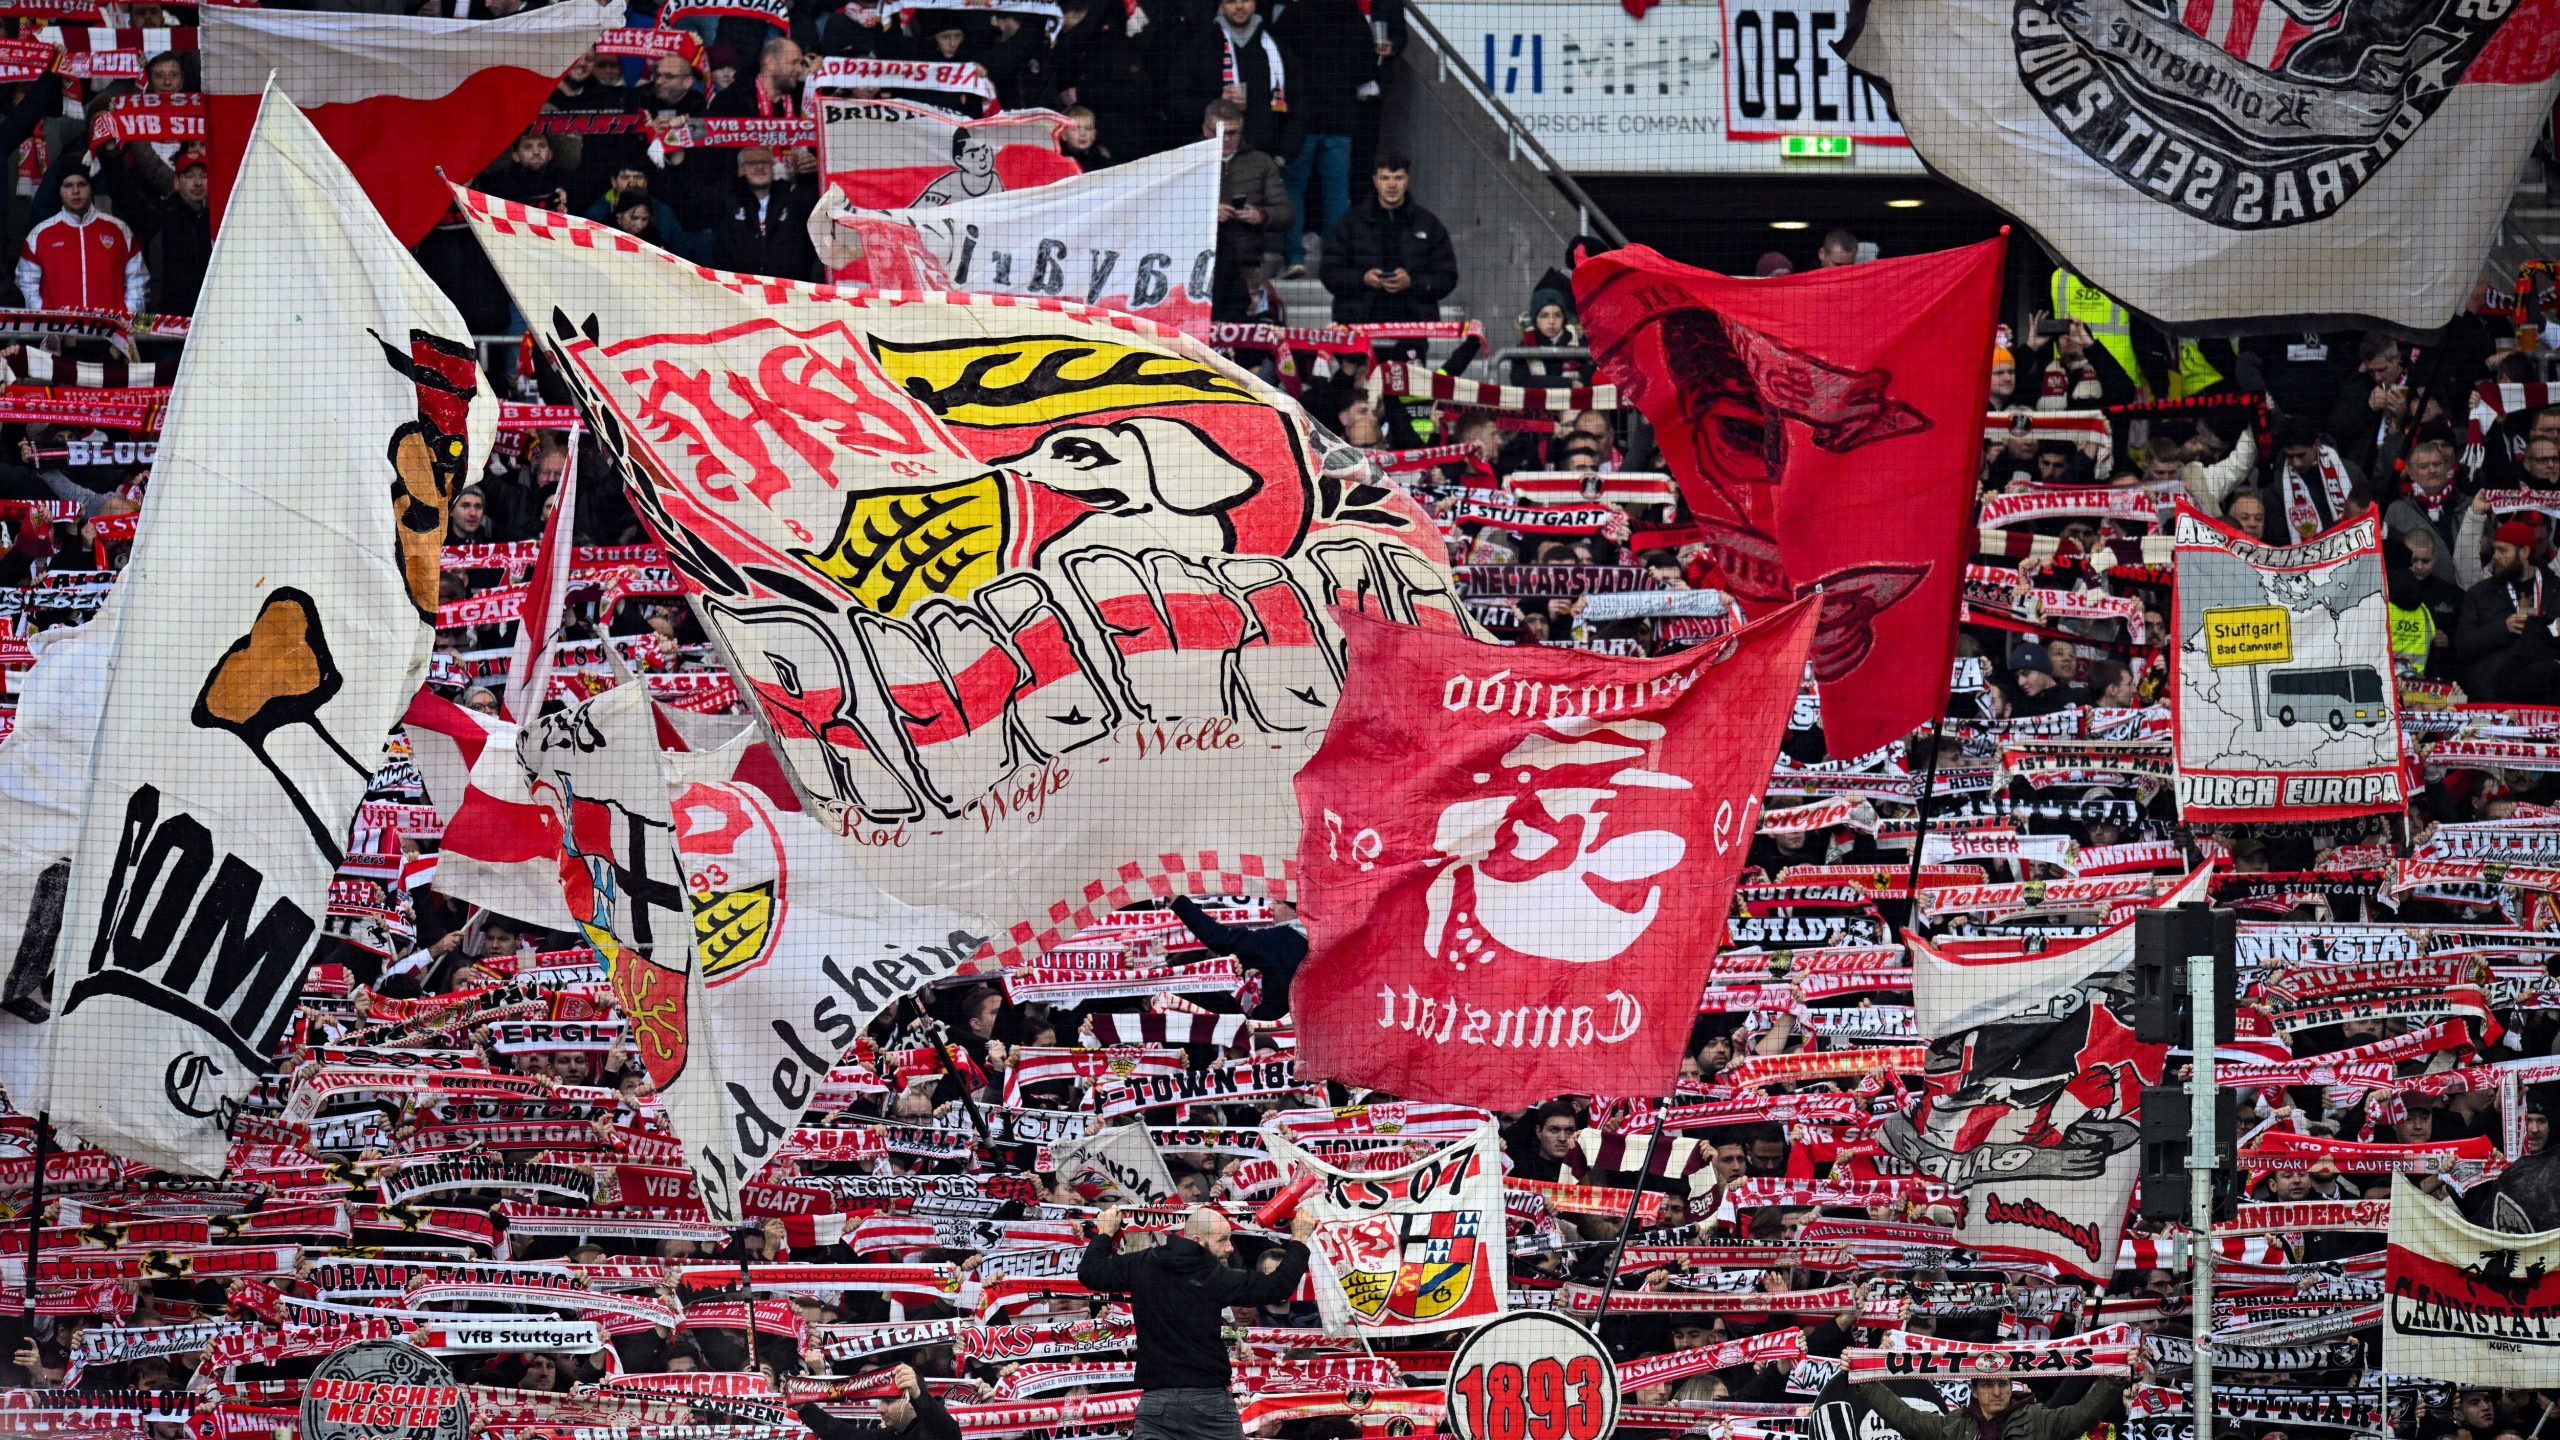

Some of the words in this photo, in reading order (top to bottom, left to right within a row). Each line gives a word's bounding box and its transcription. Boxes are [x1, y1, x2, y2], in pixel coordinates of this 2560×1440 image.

[597, 30, 682, 51] tuttgart
[119, 115, 161, 134] VfB
[708, 120, 739, 132] VfB
[1514, 115, 1609, 133] ORSCHE
[1618, 115, 1721, 134] COMPANY
[888, 459, 939, 479] 93
[1478, 502, 1605, 526] STUTTGART
[1982, 490, 2111, 524] ANNSTATTER
[2229, 518, 2376, 568] CANNSTATT
[1467, 565, 1662, 597] NECKARSTADIO
[2214, 621, 2281, 647] Stuttgart
[2396, 620, 2420, 634] SDS
[2216, 643, 2237, 655] Bad
[2238, 641, 2284, 653] Cannstatt
[1112, 715, 1246, 761] Welle
[2017, 756, 2047, 772] IST
[2055, 756, 2092, 769] DER
[2101, 756, 2125, 770] 12.
[2284, 774, 2401, 806] EUROPA
[362, 810, 397, 828] VfB
[1951, 841, 2020, 856] SIEGER
[689, 863, 730, 893] 93
[1920, 865, 1947, 874] SIND
[1934, 878, 2023, 909] Pokal
[2045, 878, 2149, 900] sieger
[2248, 884, 2269, 896] VfB
[2283, 883, 2376, 896] STUTTGART
[1790, 949, 1897, 974] sieger
[2281, 959, 2459, 994] STUTTGART
[2336, 983, 2373, 993] NEVER
[2376, 979, 2408, 989] WALK
[2411, 975, 2450, 986] ALONE
[1070, 990, 1095, 999] KURVE
[1201, 982, 1223, 992] WEISS
[2304, 1008, 2341, 1025] DER
[2350, 1004, 2379, 1017] 12.
[2386, 997, 2452, 1014] MANN!
[308, 1072, 416, 1093] STUTTGART
[441, 1102, 632, 1127] STUTTGART
[234, 1120, 302, 1147] STATT
[401, 1128, 444, 1152] VfB
[1409, 1144, 1478, 1206] 07
[1873, 1155, 1915, 1177] VfB
[2346, 1157, 2415, 1172] LAUTERN
[644, 1176, 680, 1198] VfB
[840, 1176, 925, 1199] REGIERT
[934, 1175, 979, 1198] DER
[2292, 1203, 2346, 1227] DER
[519, 1225, 543, 1234] GANZE
[544, 1226, 569, 1235] KURVE
[629, 1228, 648, 1236] MEIN
[650, 1229, 670, 1237] HERZ
[671, 1230, 681, 1238] IN
[682, 1230, 707, 1239] WEISS
[1572, 1289, 1742, 1312] CANNSTATTER
[1771, 1287, 1853, 1311] KURVE
[754, 1308, 784, 1322] ann!
[2246, 1307, 2311, 1323] HEISST
[457, 1330, 493, 1345] VfB
[499, 1329, 594, 1347] Stuttgart
[2488, 1341, 2522, 1353] KURVE
[310, 1378, 460, 1408] DEUTSCHER
[1455, 1354, 1605, 1440] 1893
[326, 1402, 441, 1428] MEISTER
[686, 1397, 785, 1425] KÄMPFEN!
